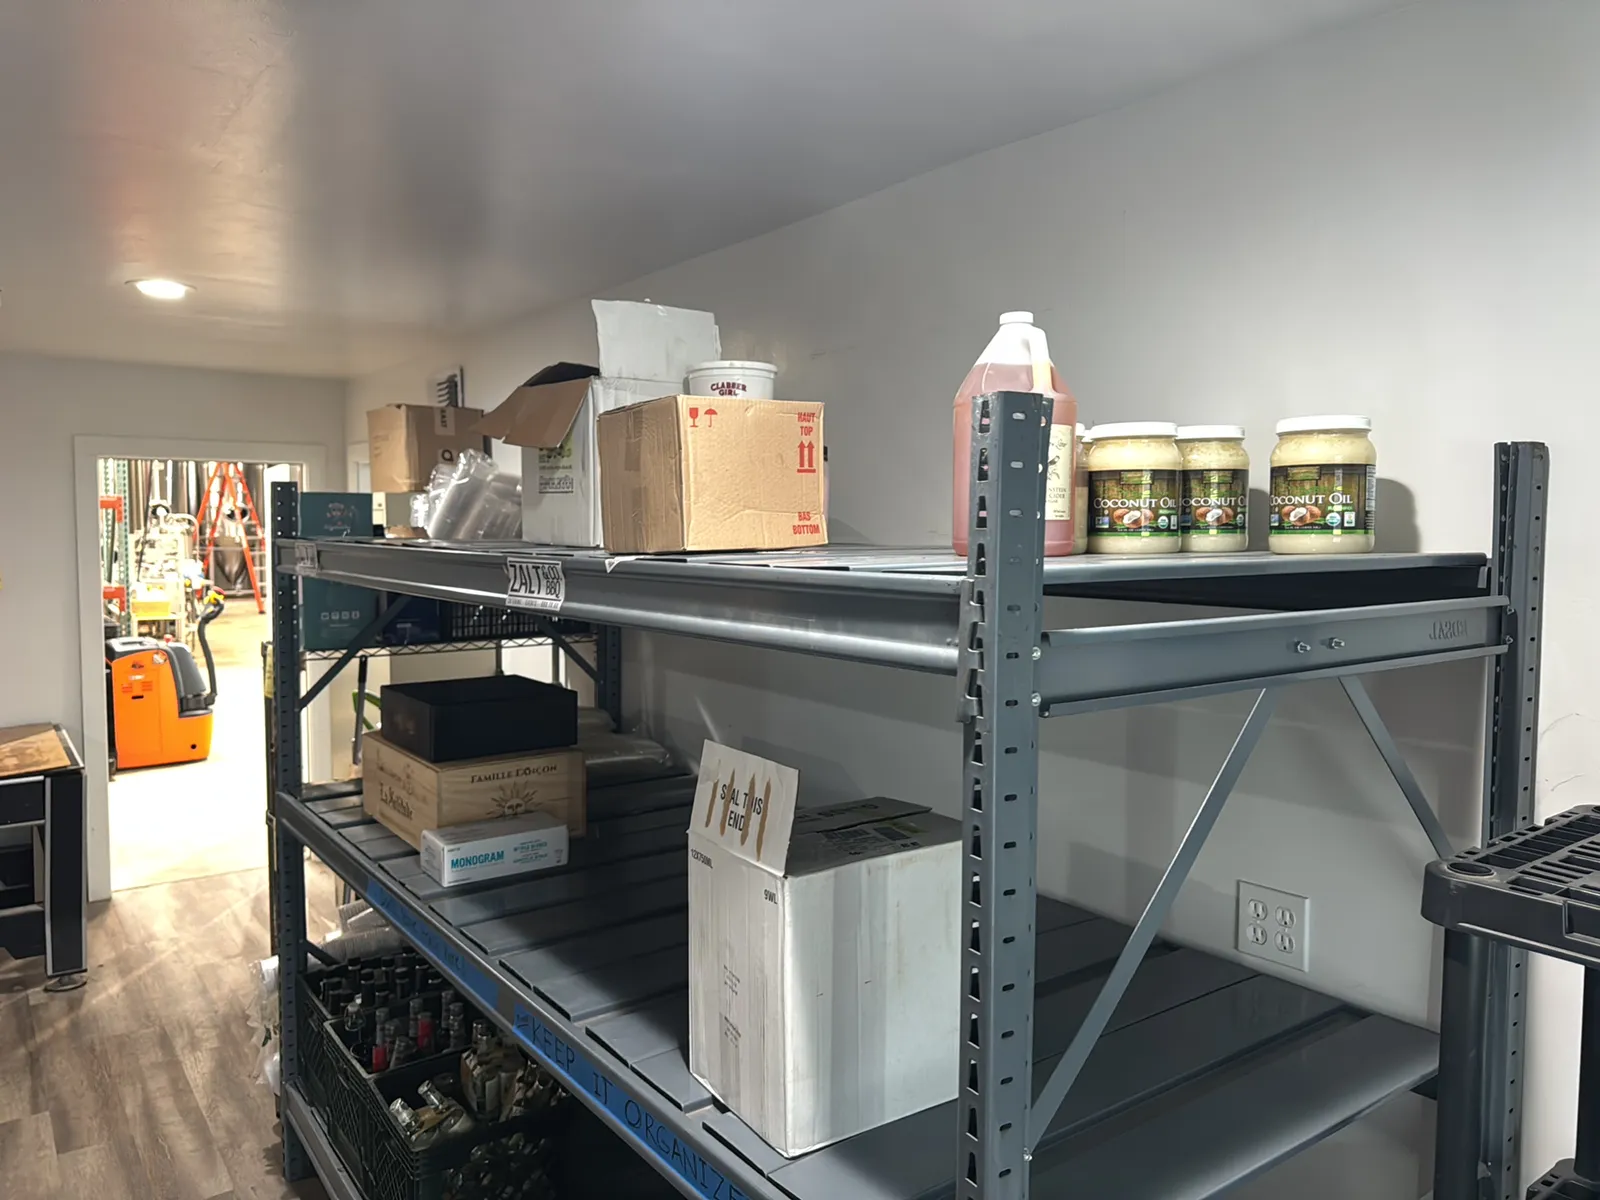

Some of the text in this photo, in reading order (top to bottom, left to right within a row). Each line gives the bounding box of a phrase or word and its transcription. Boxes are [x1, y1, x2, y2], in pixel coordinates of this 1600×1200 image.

[710, 381, 747, 392] CLABBER
[718, 389, 738, 397] GIRL
[797, 411, 816, 423] HAUT
[800, 426, 814, 437] TOP
[1182, 497, 1237, 507] OCONUT
[797, 511, 812, 521] BAS
[792, 523, 821, 535] BOTTOM
[509, 564, 541, 595] ZALT
[545, 580, 561, 598] BBQ
[470, 771, 513, 784] FAMILLE
[720, 783, 764, 816] SAL TIS
[728, 810, 745, 832] END
[450, 850, 505, 870] MONOGRAM
[532, 1015, 575, 1072] KEEP
[591, 1072, 614, 1104] IT
